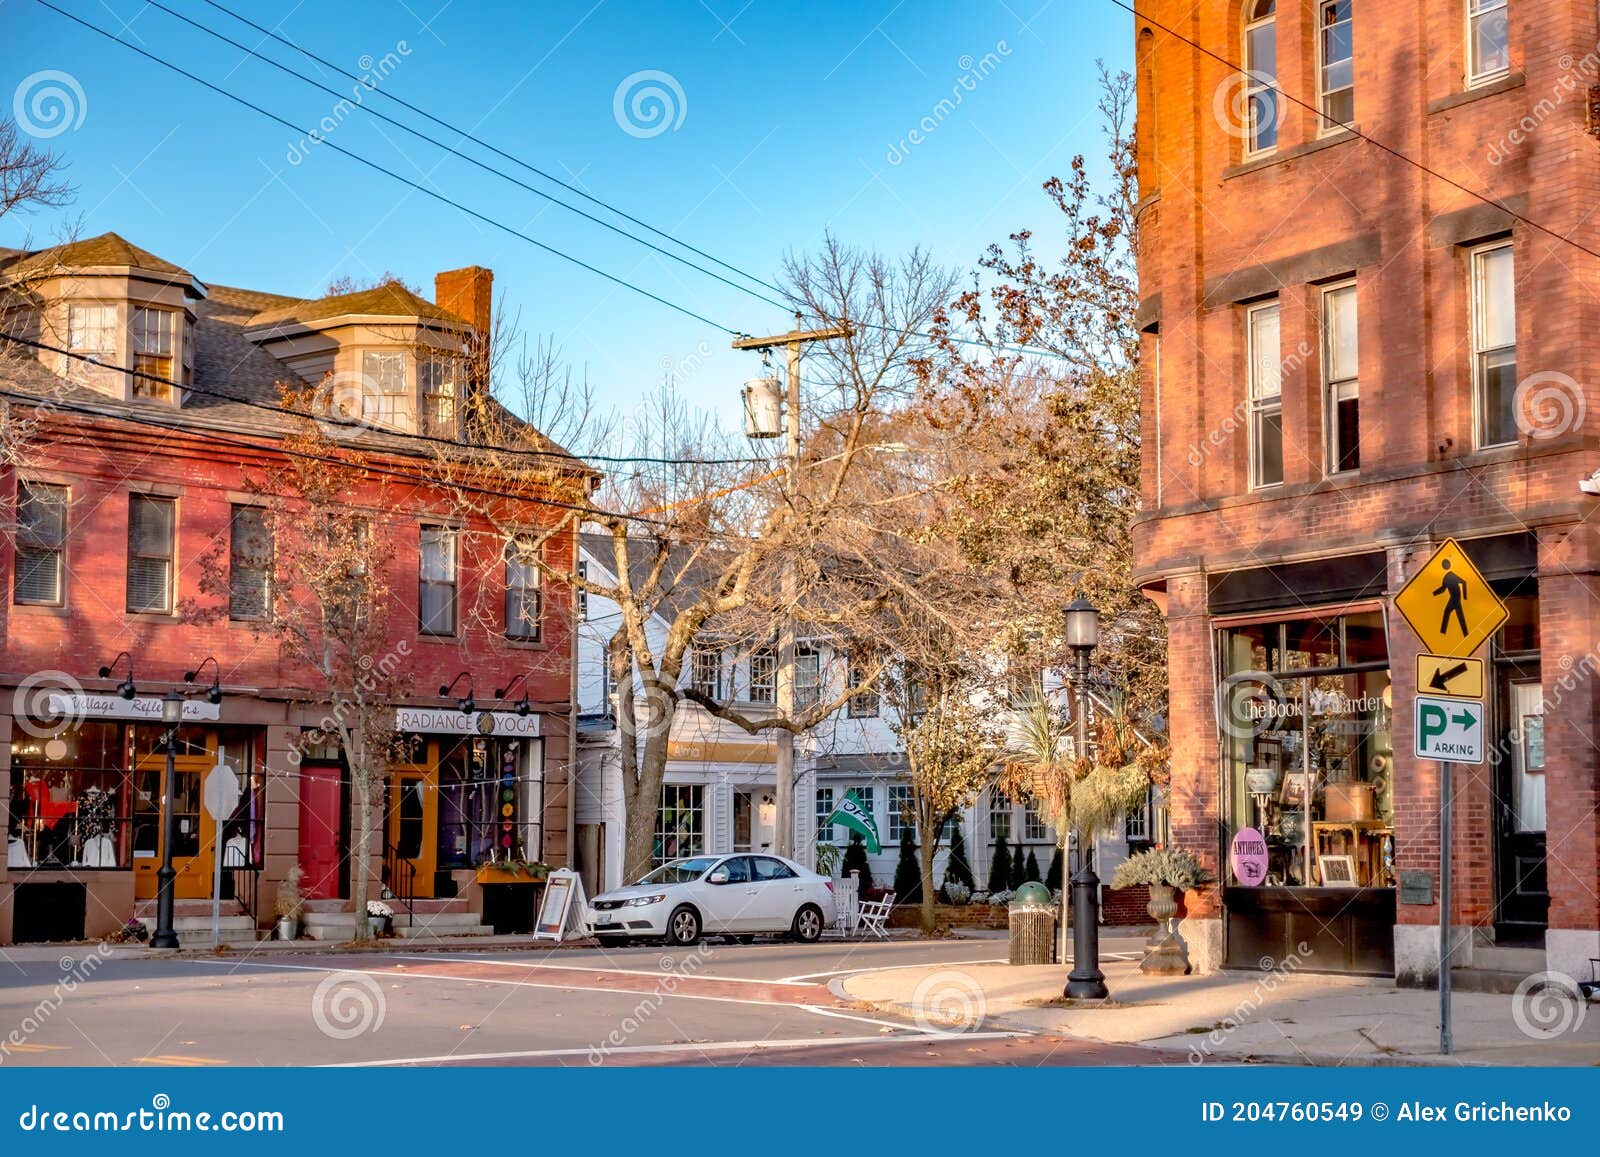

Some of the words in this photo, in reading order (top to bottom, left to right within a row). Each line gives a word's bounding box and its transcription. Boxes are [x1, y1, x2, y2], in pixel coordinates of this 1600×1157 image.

[72, 696, 114, 714] Village
[131, 700, 199, 716] Reflens
[1242, 699, 1266, 719] The
[1269, 696, 1303, 717] Book
[402, 713, 472, 730] RADIANCE
[495, 717, 535, 732] YOGA
[843, 800, 876, 831] OPE
[1233, 841, 1264, 855] ANTIQUES
